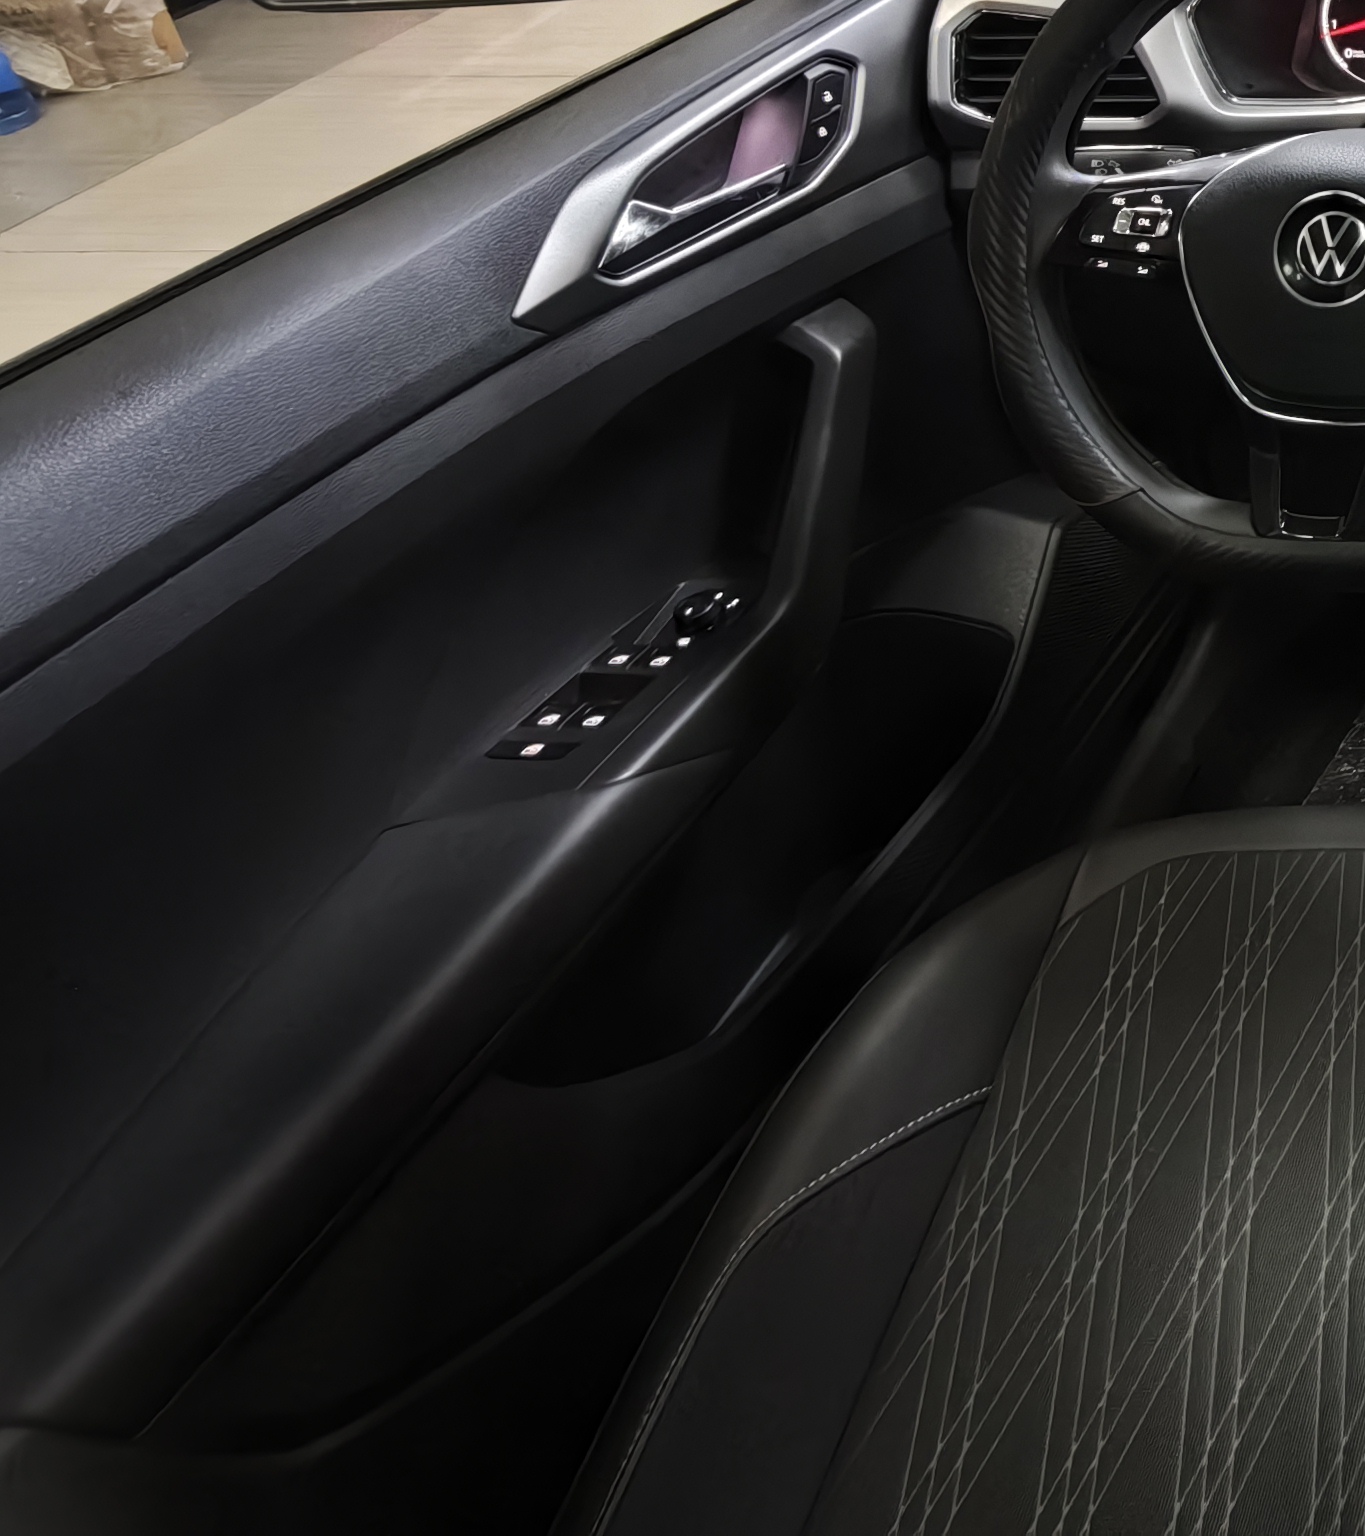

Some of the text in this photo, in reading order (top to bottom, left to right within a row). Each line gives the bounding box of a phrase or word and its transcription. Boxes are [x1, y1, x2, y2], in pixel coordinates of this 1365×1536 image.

[1331, 19, 1337, 29] 1
[1344, 48, 1352, 58] 0
[1112, 197, 1126, 206] RES
[1091, 234, 1105, 243] SET
